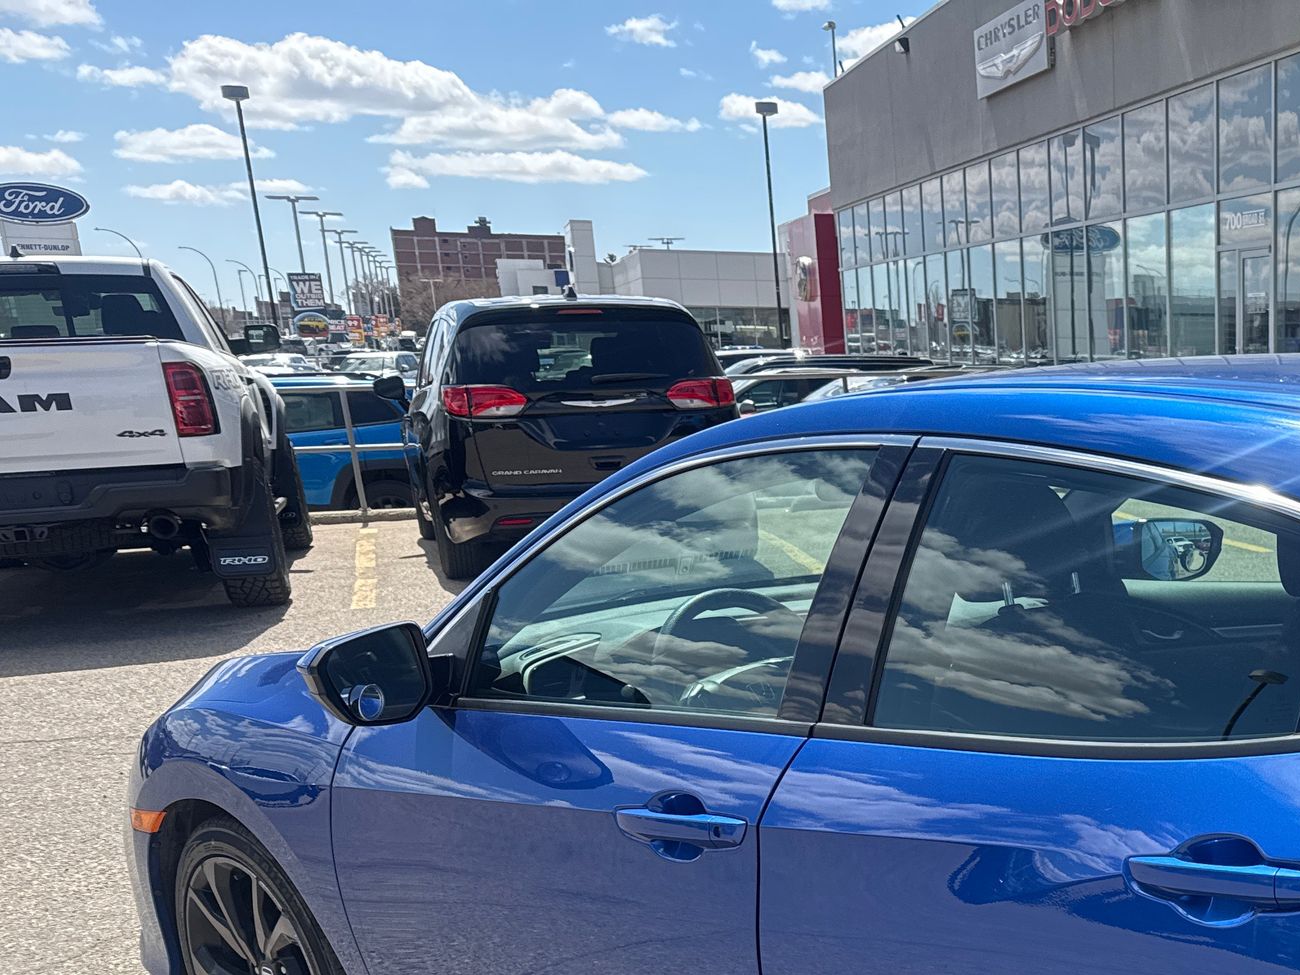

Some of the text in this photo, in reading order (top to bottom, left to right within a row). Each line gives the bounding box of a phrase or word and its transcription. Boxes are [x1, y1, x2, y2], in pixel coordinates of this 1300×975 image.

[976, 3, 1040, 51] CHRYSLER
[0, 188, 64, 215] Ford
[1226, 212, 1242, 230] 700
[17, 243, 69, 252] ENNETT-DUNLOP
[292, 281, 322, 293] WE
[296, 298, 326, 306] THEM
[116, 429, 168, 438] 4x4
[219, 556, 269, 565] RHO
